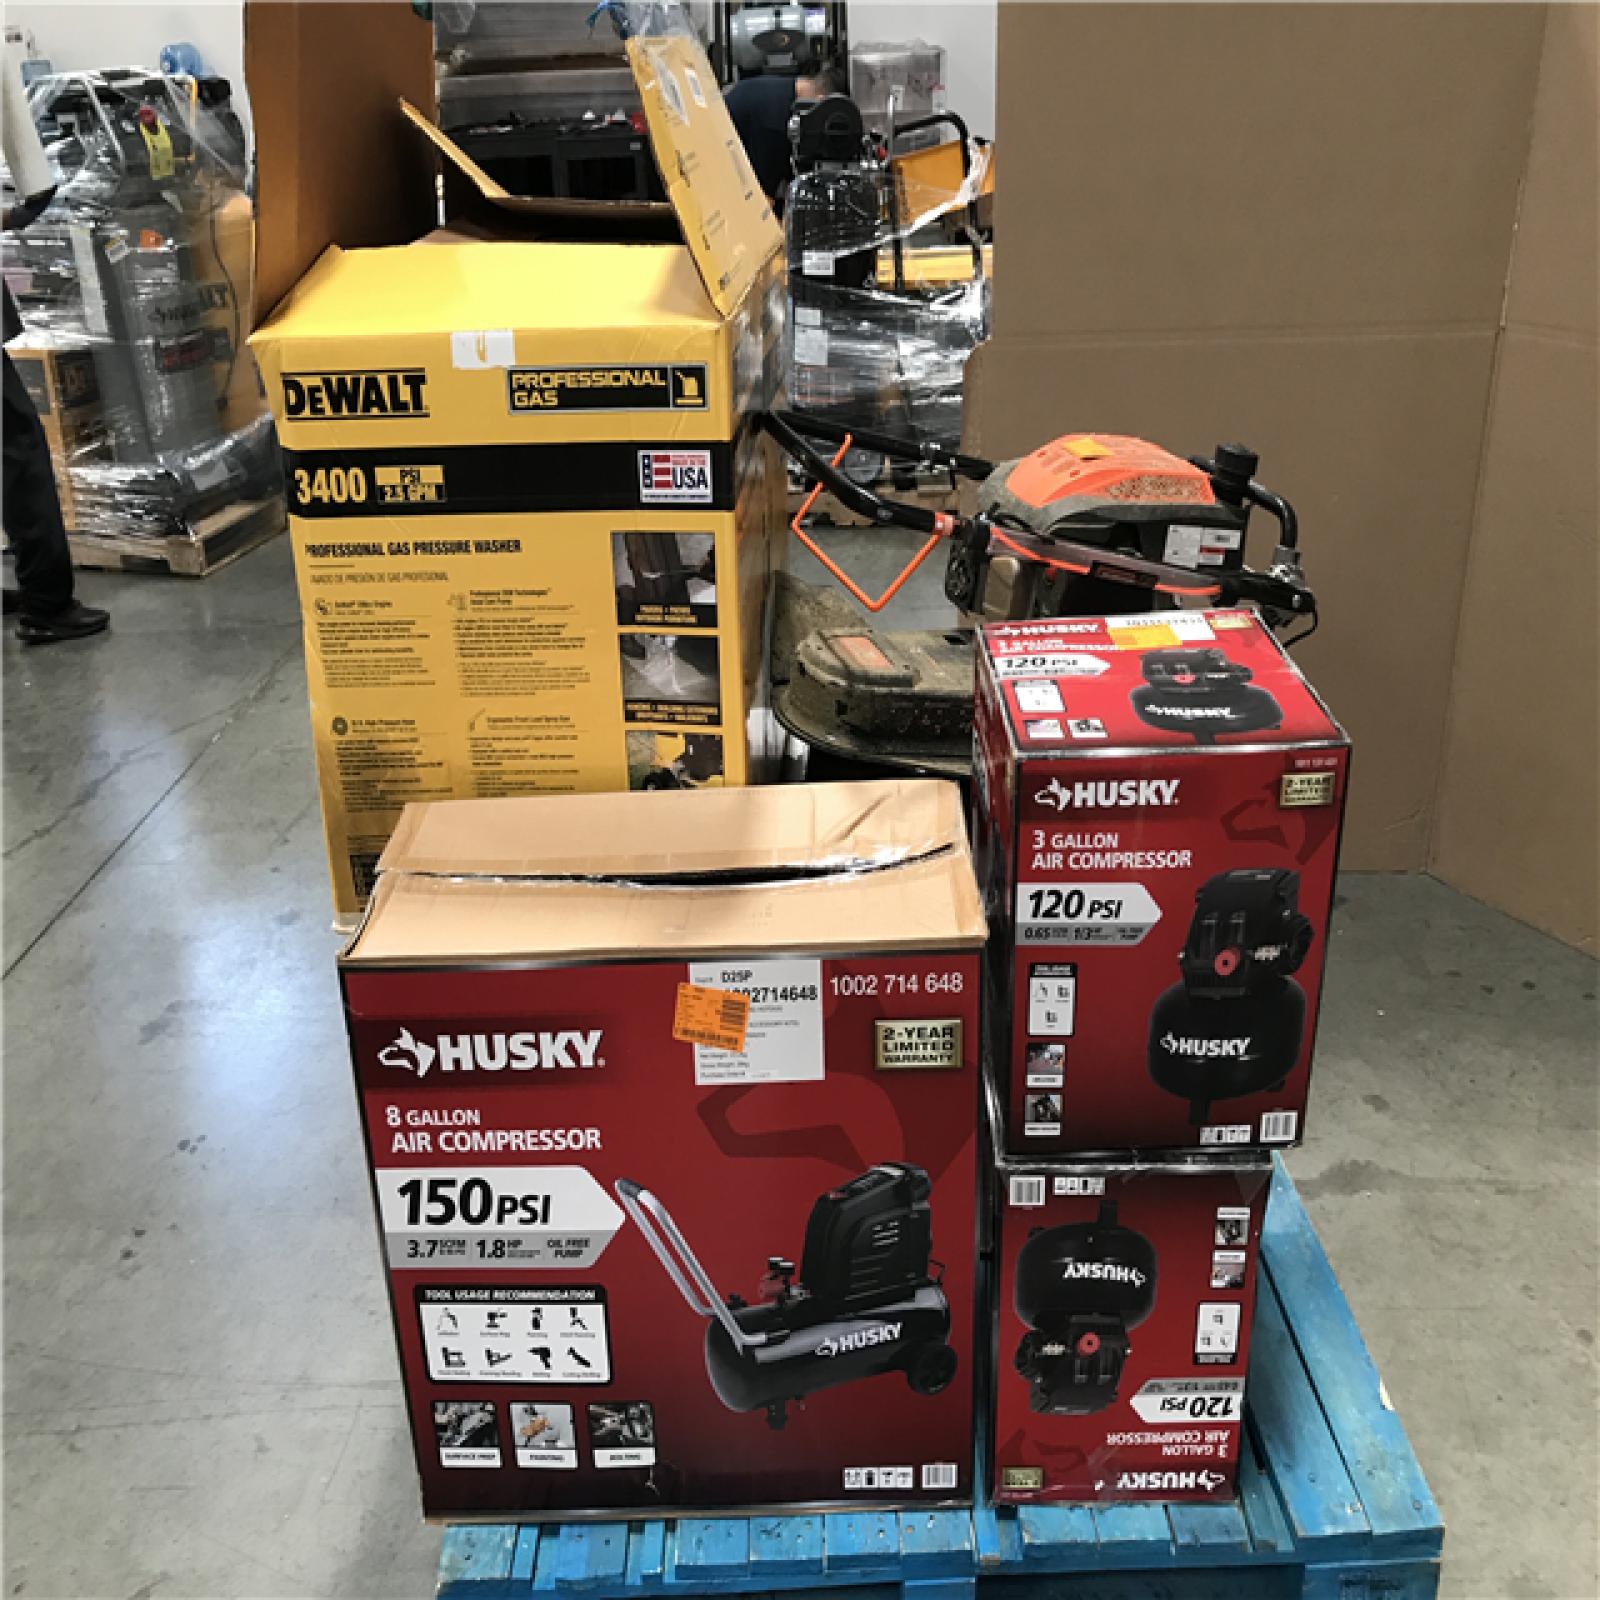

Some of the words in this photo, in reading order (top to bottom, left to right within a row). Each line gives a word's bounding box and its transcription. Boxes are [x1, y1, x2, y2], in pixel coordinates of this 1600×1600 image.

[511, 369, 666, 388] PROFESSIONAL
[514, 389, 558, 408] GAS
[294, 467, 367, 505] 3400
[672, 467, 708, 489] USA
[387, 541, 411, 556] GAS
[413, 540, 471, 556] PRESSURE
[473, 540, 521, 554] WASHER
[1006, 657, 1046, 668] 120
[1074, 779, 1180, 808] HUSKY
[1032, 829, 1046, 849] 3
[1051, 833, 1118, 849] GALLON
[1032, 852, 1063, 870] AIR
[1068, 850, 1192, 870] COMPRESSOR
[1029, 889, 1086, 919] 120
[1088, 899, 1124, 919] PSI
[830, 973, 879, 996] 1002
[884, 973, 919, 994] 714
[924, 971, 964, 993] 648
[883, 1026, 954, 1041] 2-YEAR
[436, 1030, 604, 1071] HUSKY
[883, 1041, 954, 1052] LIMITED
[1179, 1036, 1251, 1056] HUSKY
[883, 1053, 954, 1064] WARRANTY
[385, 1105, 401, 1127] 8
[406, 1109, 481, 1126] GALLON
[392, 1131, 433, 1153] AIR
[439, 1128, 603, 1153] COMPRESSOR
[396, 1177, 493, 1225] 150
[496, 1194, 552, 1225] PSI
[407, 1239, 438, 1258] 3.7
[475, 1239, 506, 1258] 1.8
[1063, 1262, 1130, 1282] HUSKY
[424, 1289, 453, 1300] TOOL
[455, 1289, 491, 1300] USAGE
[492, 1289, 596, 1300] RECOMMENDATION
[839, 1321, 903, 1353] HUSKY
[1160, 1396, 1187, 1411] PSI
[1189, 1396, 1234, 1418] 120
[1106, 1430, 1202, 1446] COMPRESSOR
[1204, 1429, 1230, 1442] AIR
[1162, 1444, 1214, 1456] GALLON
[1217, 1445, 1228, 1458] 3
[1116, 1471, 1196, 1489] HUSKY
